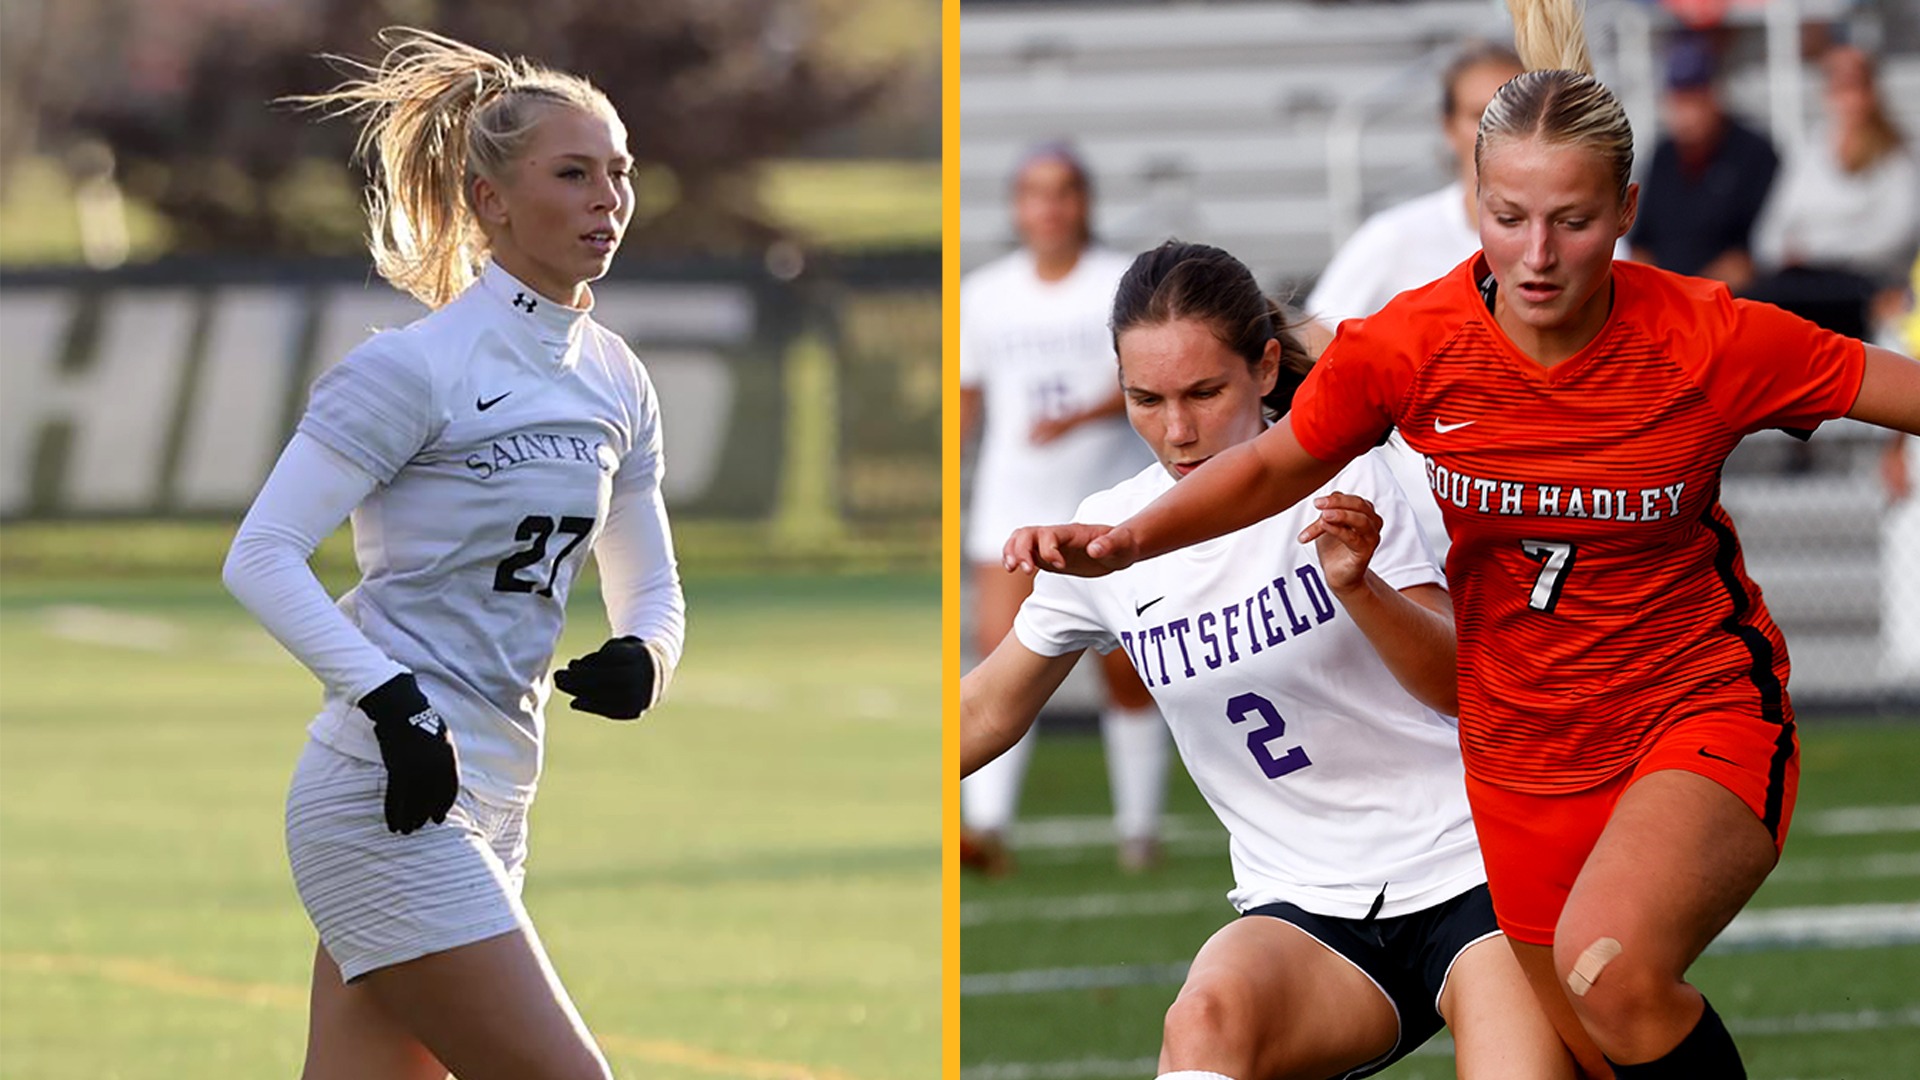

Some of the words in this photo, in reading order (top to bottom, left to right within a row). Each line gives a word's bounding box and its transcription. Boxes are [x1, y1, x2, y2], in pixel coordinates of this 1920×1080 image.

[465, 433, 562, 480] SAINT
[1424, 456, 1524, 515] SOUTH
[1536, 481, 1686, 522] HADLEY
[493, 515, 596, 598] 27
[1521, 538, 1577, 613] 7
[1226, 692, 1313, 780] 2
